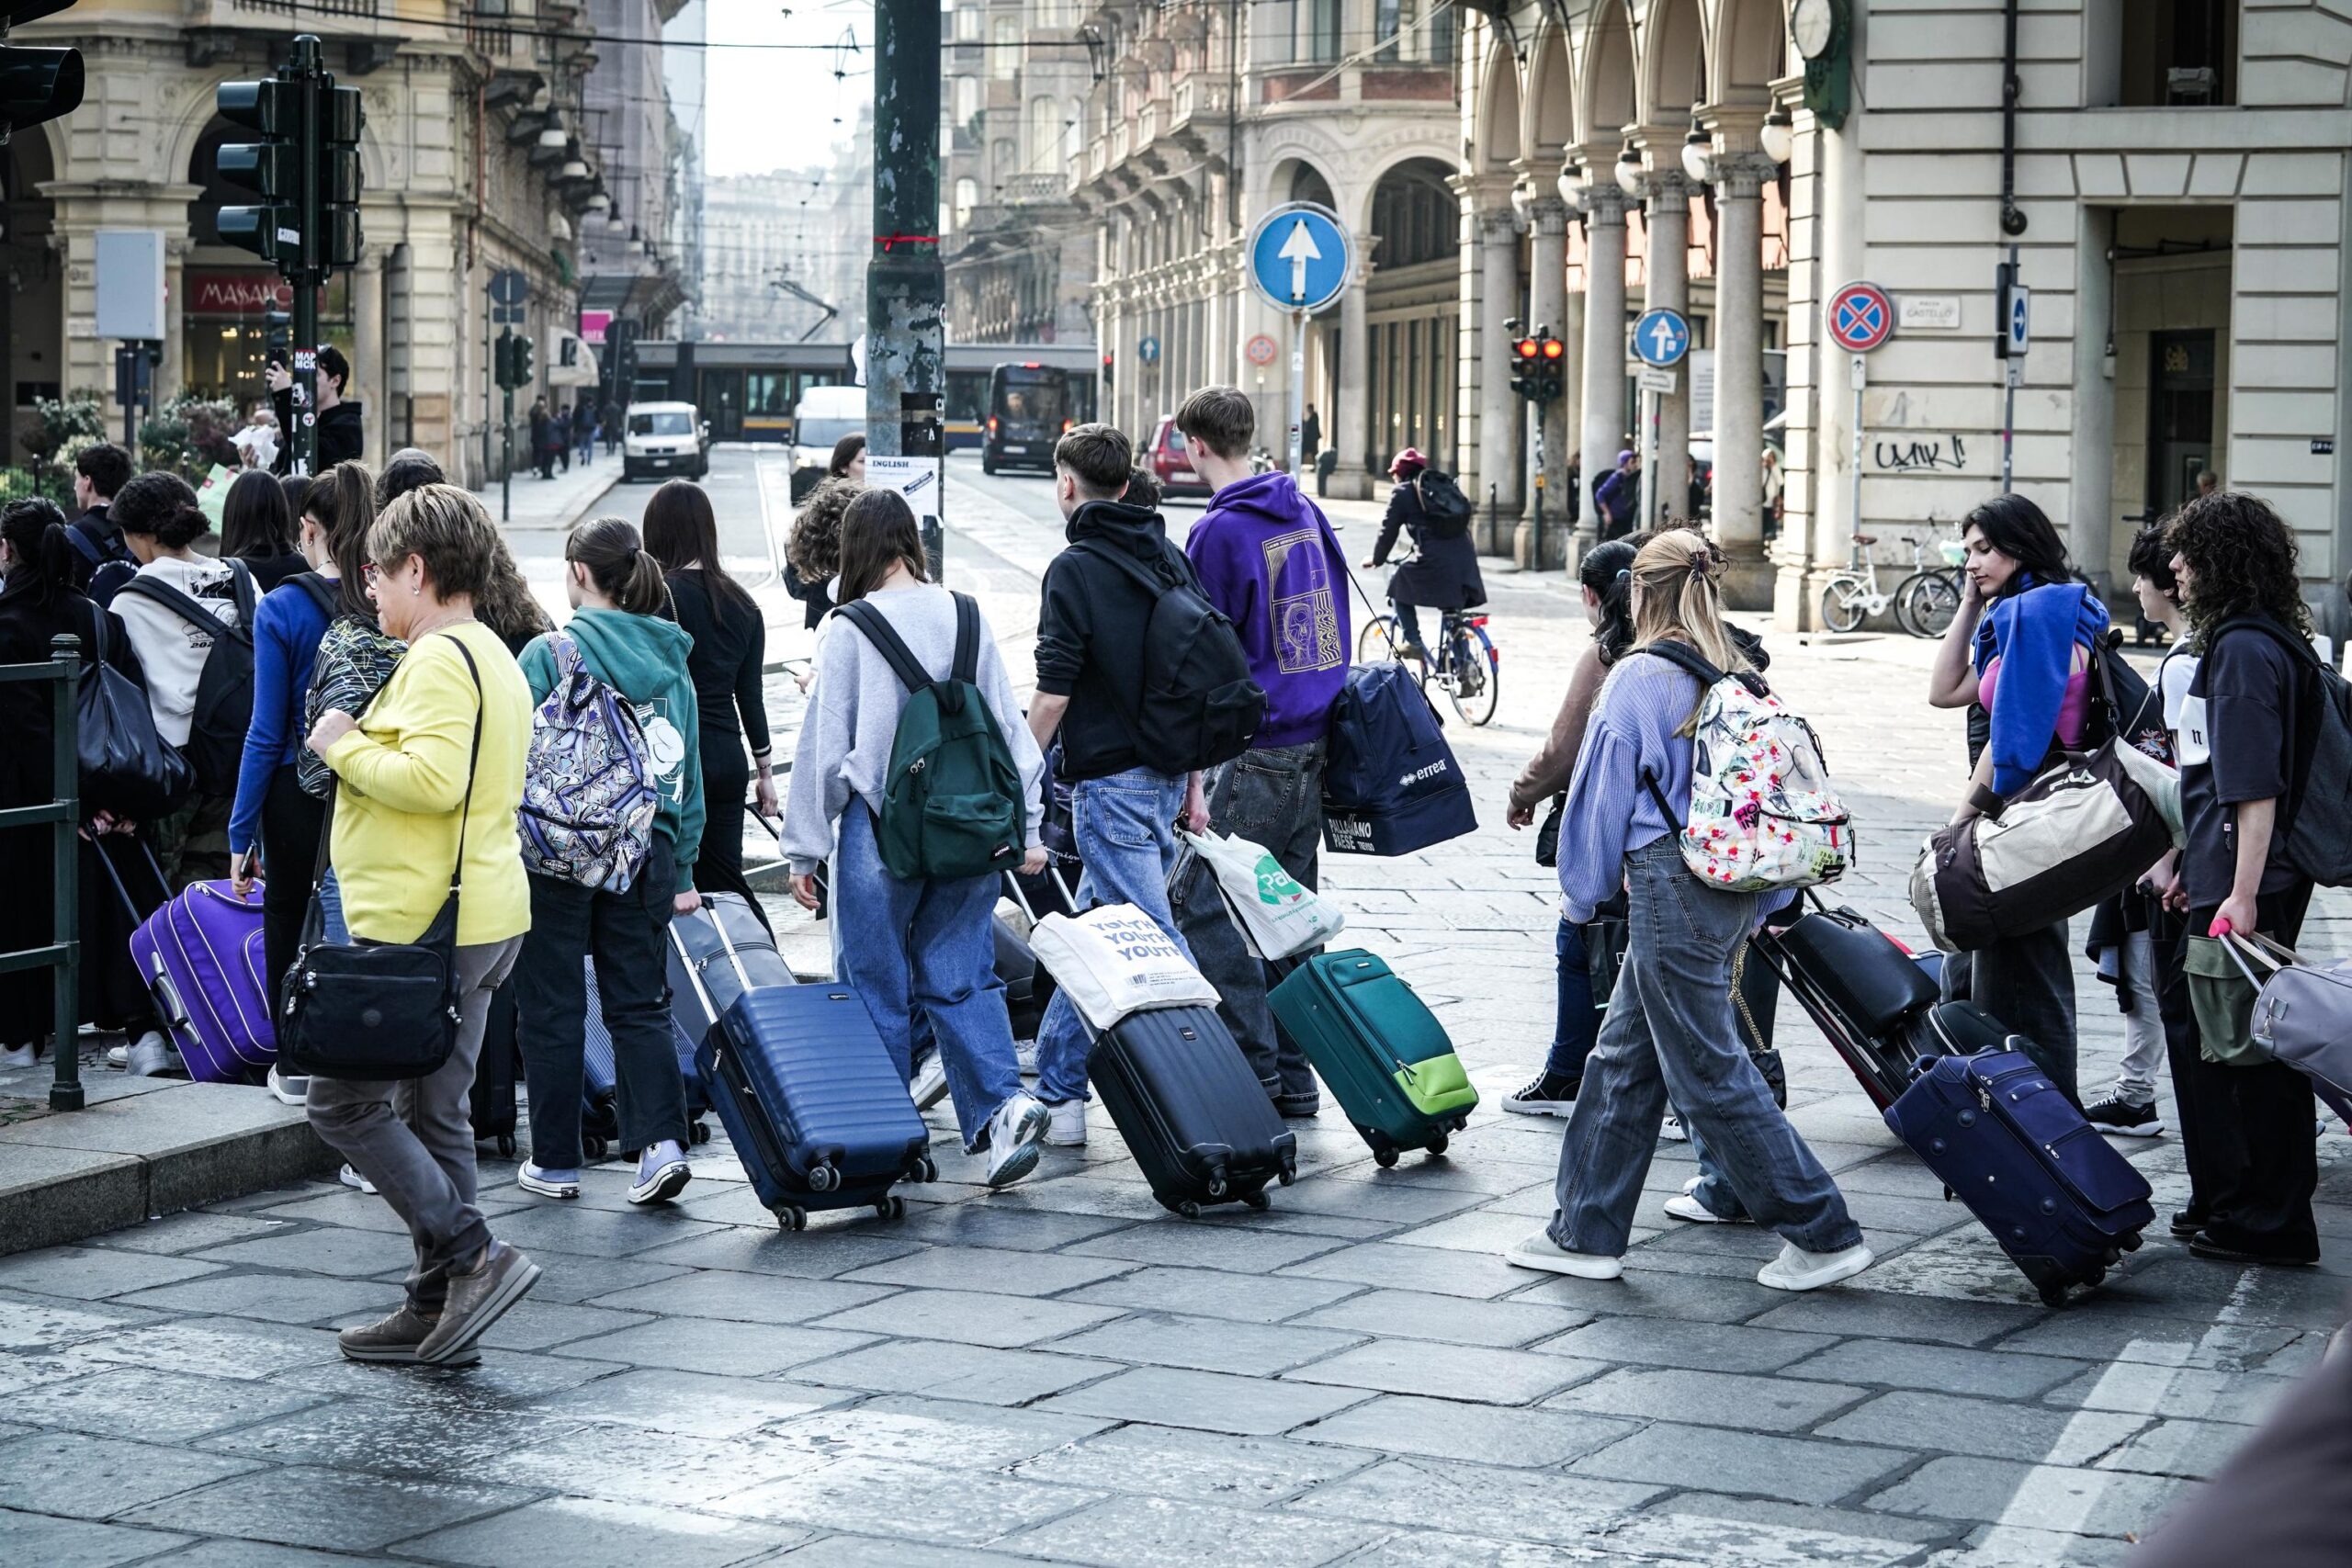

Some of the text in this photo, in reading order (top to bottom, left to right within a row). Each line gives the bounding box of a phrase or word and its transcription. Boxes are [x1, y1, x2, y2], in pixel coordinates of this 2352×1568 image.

[295, 351, 316, 361] MAP
[295, 360, 316, 369] MCK
[872, 460, 909, 468] ENGLISH
[1333, 833, 1356, 850] PAESE
[1103, 931, 1171, 945] YOUTH
